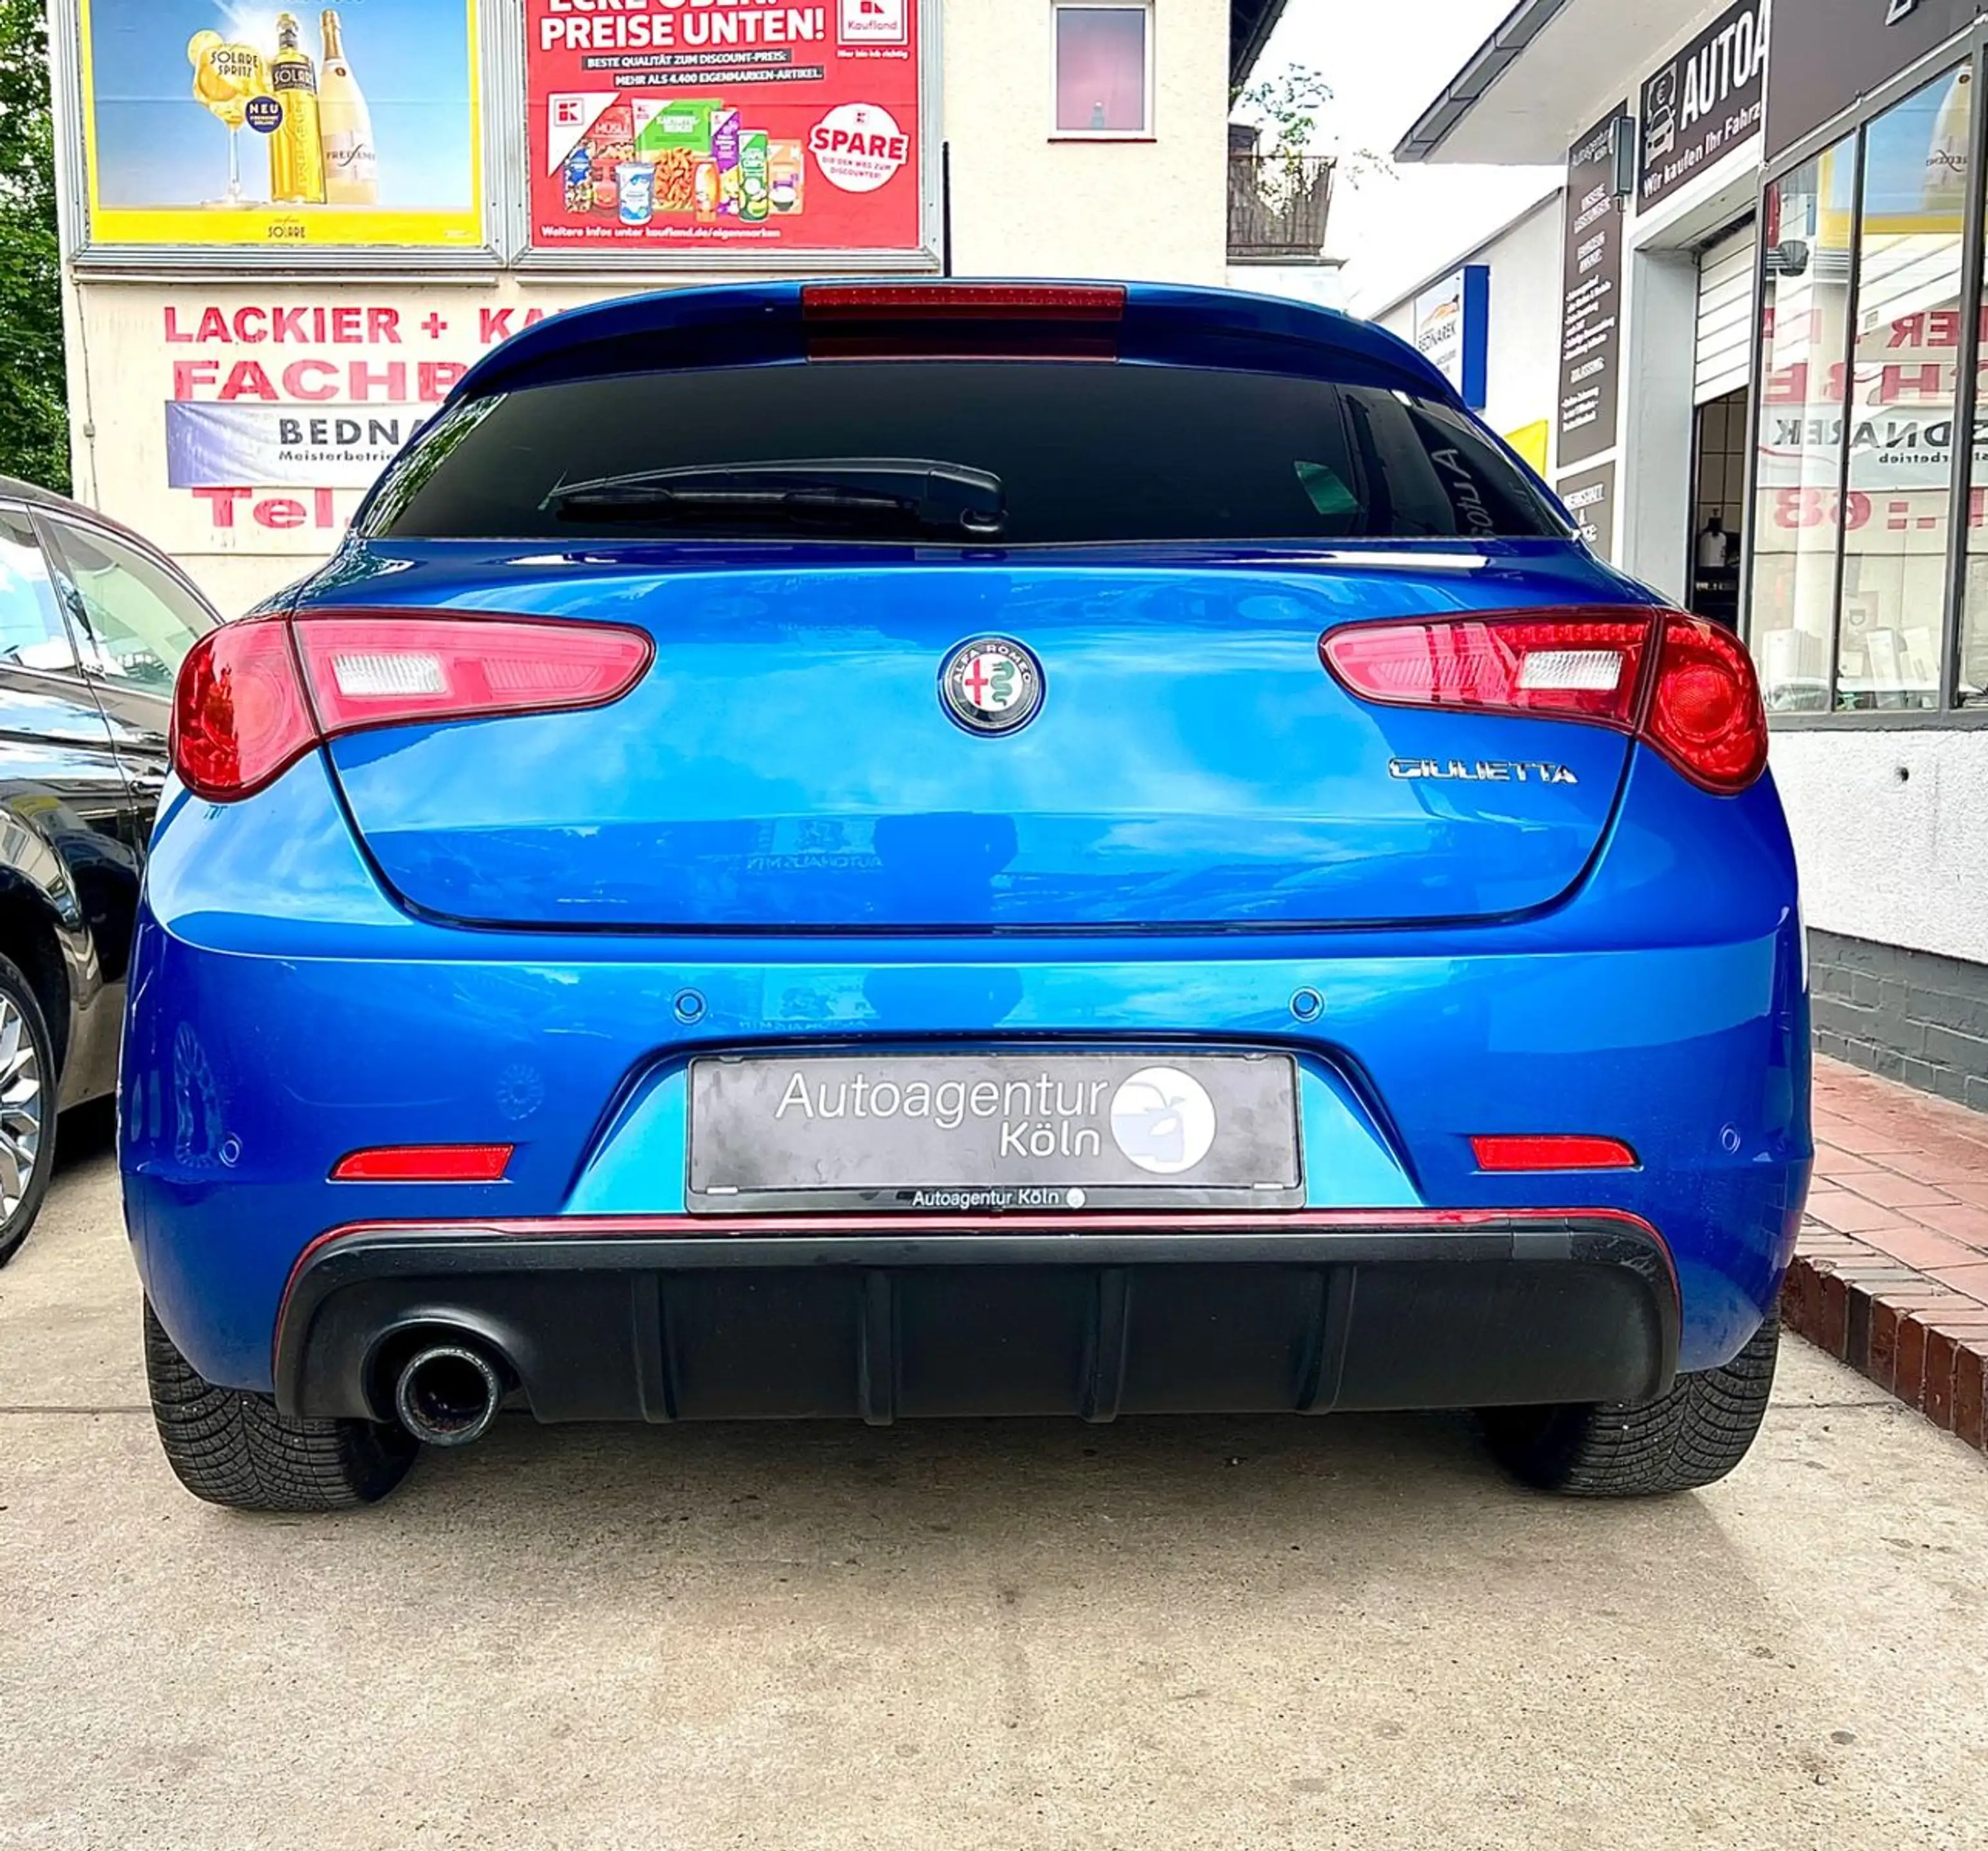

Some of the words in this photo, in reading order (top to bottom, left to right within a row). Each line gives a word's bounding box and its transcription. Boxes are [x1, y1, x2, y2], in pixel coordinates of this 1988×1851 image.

[541, 13, 674, 50] PREISE
[683, 8, 825, 45] UNTEN!
[848, 20, 898, 30] Kaufland
[210, 50, 258, 68] SOLARE
[587, 57, 620, 68] BESTE
[622, 54, 672, 67] QUALITÄT
[674, 54, 698, 65] ZUM
[615, 75, 645, 86] MEHR
[648, 74, 667, 85] ALS
[249, 103, 279, 115] NEU
[814, 127, 905, 161] SPARE
[1643, 172, 1663, 198] Wir
[1663, 144, 1703, 185] kaufen
[1705, 129, 1723, 156] Ihr
[165, 307, 402, 343] LACKIER
[954, 648, 981, 684] ALFA
[986, 644, 1032, 685] ROMEO
[1388, 758, 1579, 784] GIULIETTA
[775, 1072, 1109, 1129] Autoagentur
[1001, 1120, 1100, 1157] Köln
[912, 1190, 1013, 1210] Autoagentur
[1017, 1188, 1059, 1205] Köln
